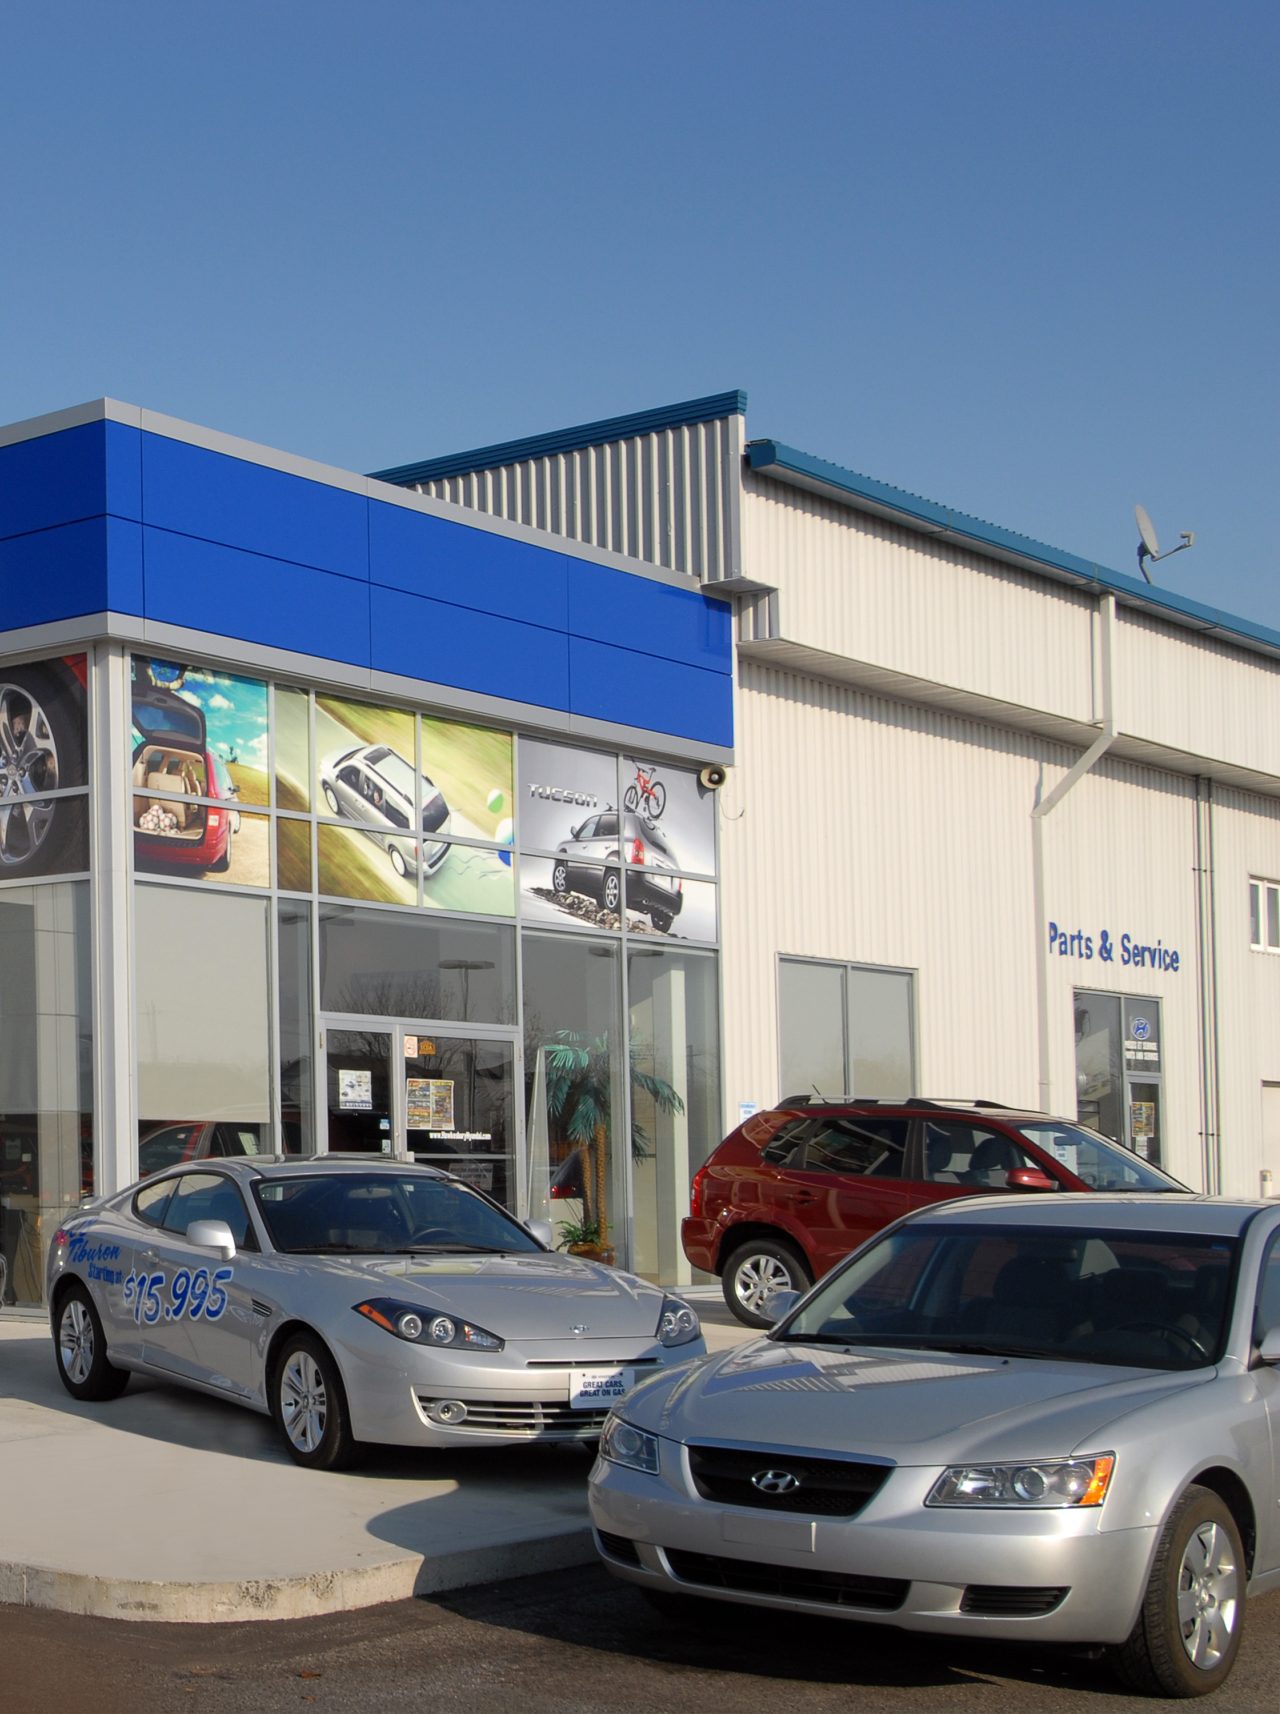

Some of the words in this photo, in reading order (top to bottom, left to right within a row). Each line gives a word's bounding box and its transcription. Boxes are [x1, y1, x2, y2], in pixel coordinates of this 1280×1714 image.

[1048, 921, 1093, 961] Parts
[1098, 929, 1114, 962] &
[1120, 933, 1180, 972] Service
[68, 1237, 121, 1264] Tiburon
[580, 1388, 600, 1397] GREAT
[602, 1388, 611, 1396] ON
[583, 1381, 603, 1389] GREAT
